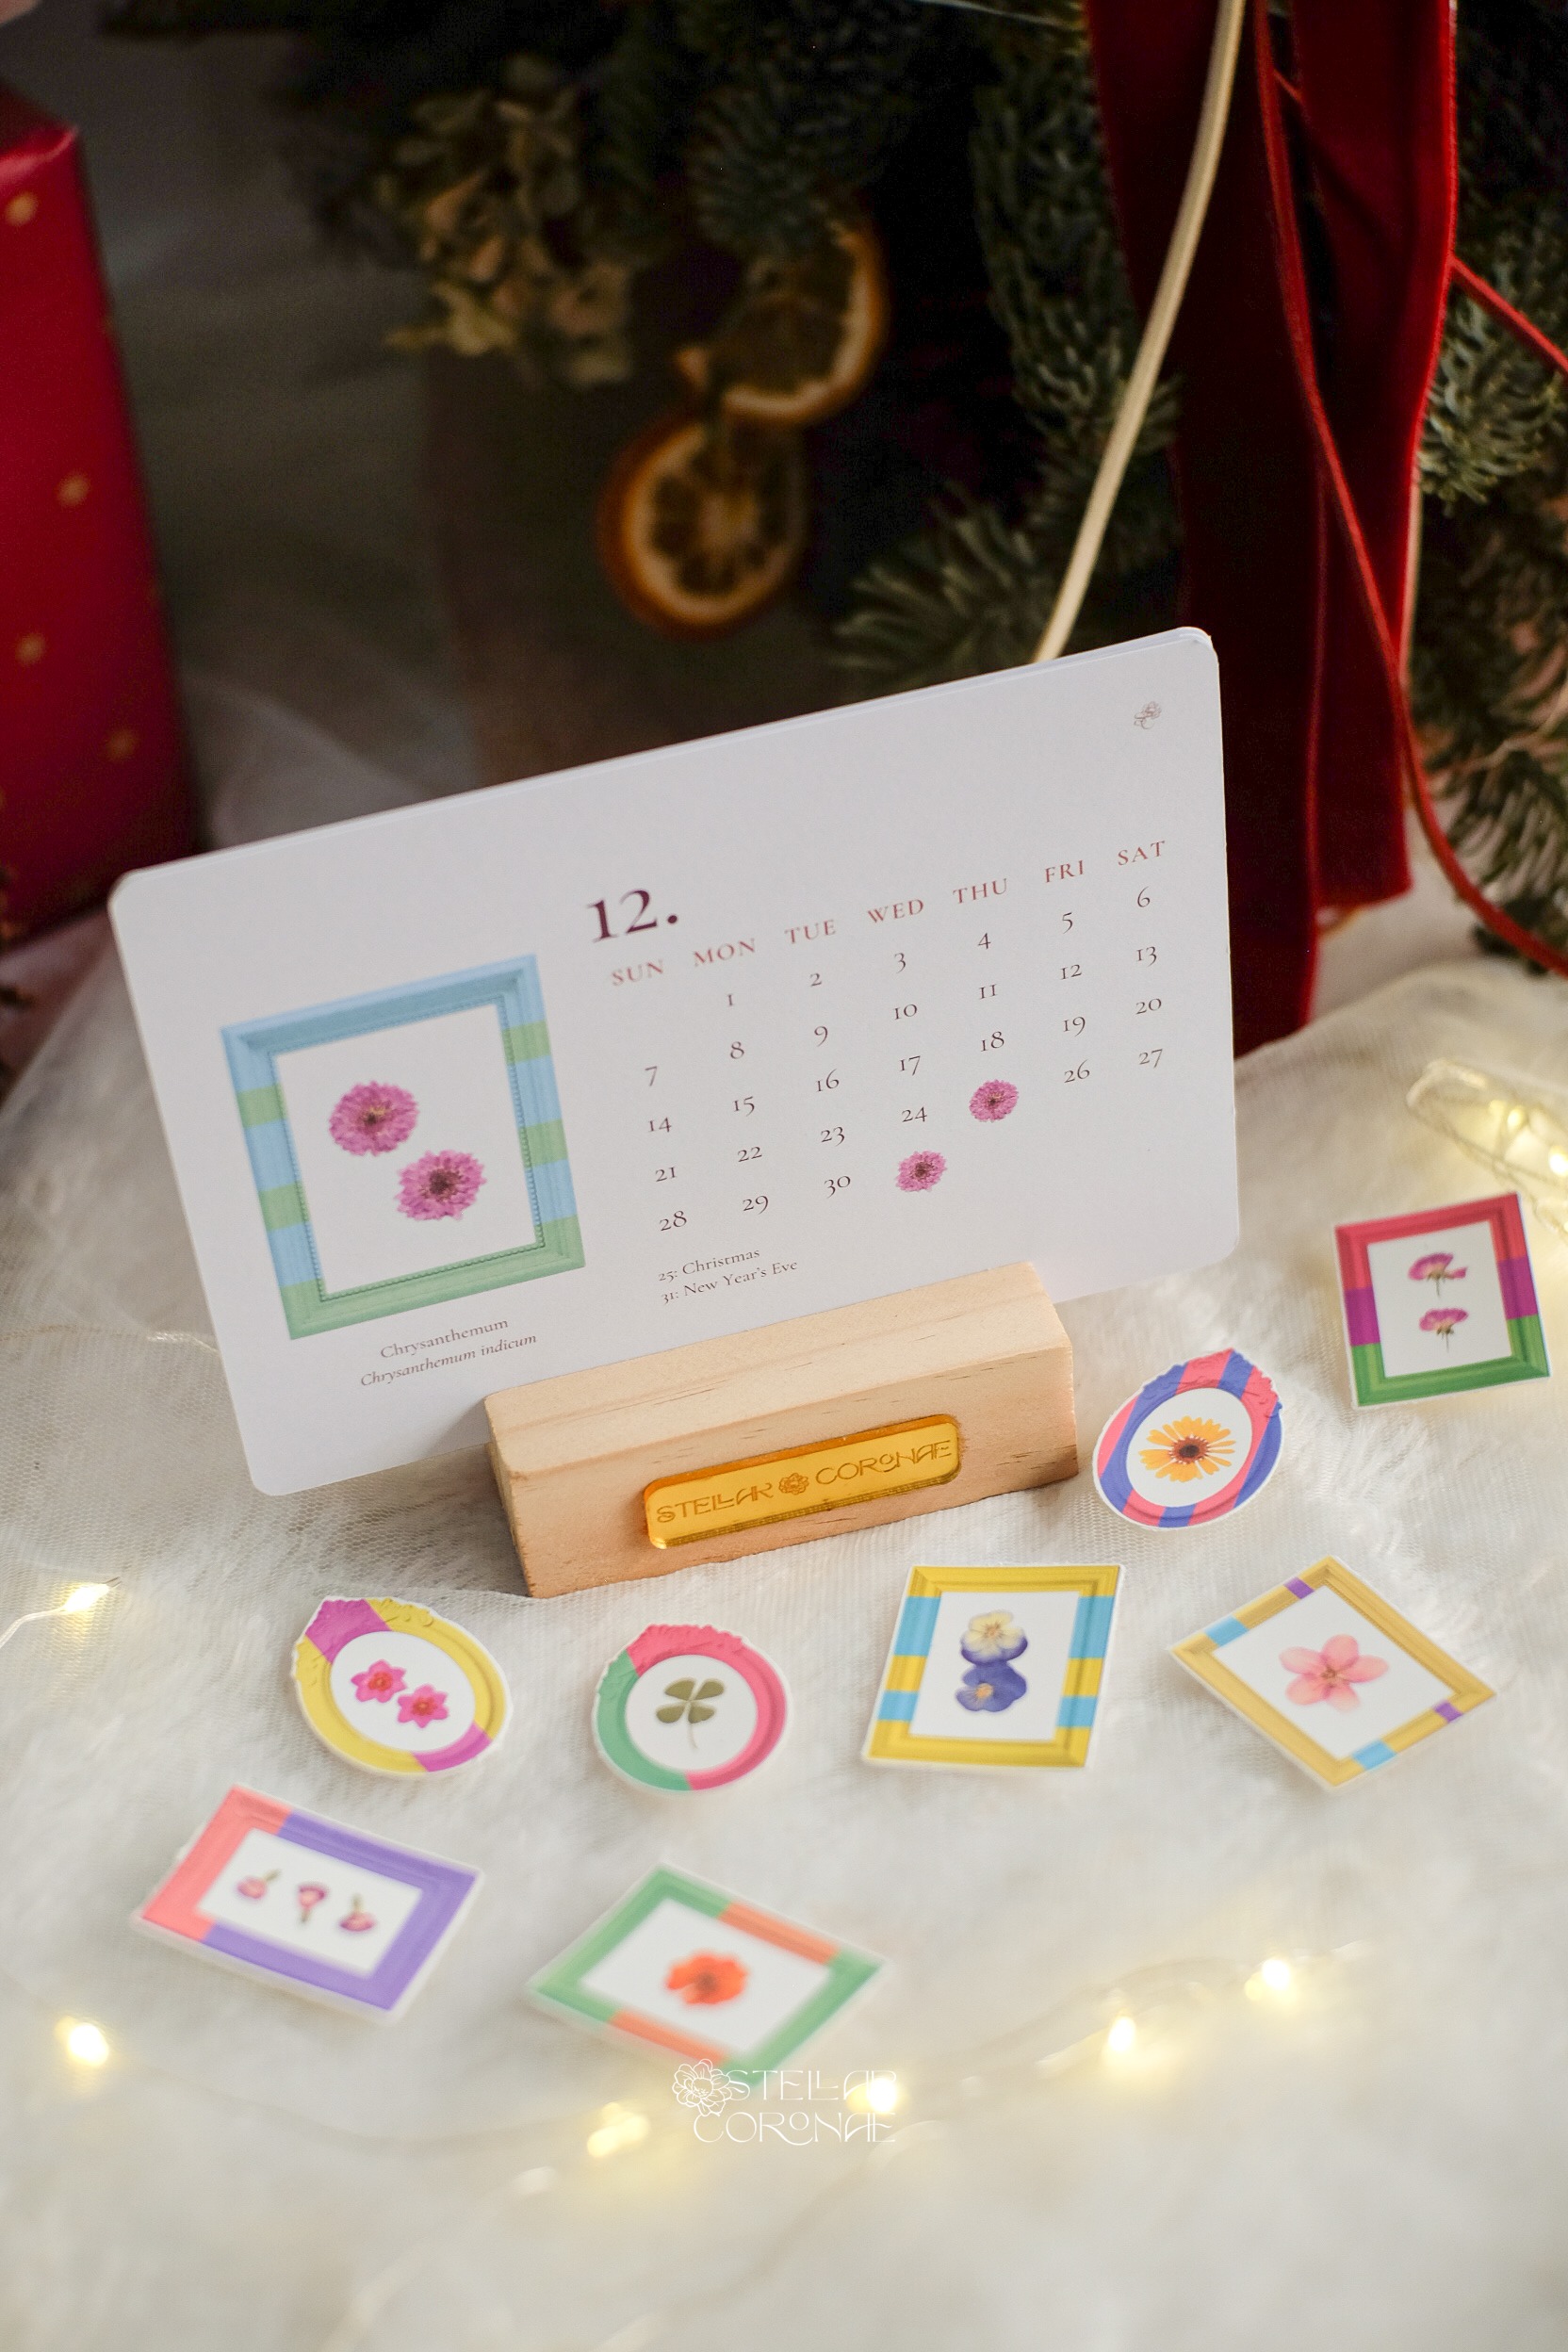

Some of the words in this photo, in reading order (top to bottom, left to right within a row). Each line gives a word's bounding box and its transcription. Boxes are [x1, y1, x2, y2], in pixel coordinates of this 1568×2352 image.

[586, 888, 679, 943] 12.
[611, 959, 664, 987] SUN
[693, 938, 756, 967] MON
[784, 919, 837, 944] TUE
[867, 898, 924, 924] WED
[952, 877, 1008, 905] THU
[1044, 859, 1085, 883] FRI
[1117, 840, 1166, 866] SAT
[727, 992, 734, 1007] 1
[809, 972, 823, 988] 2
[893, 952, 906, 974] 3
[976, 932, 992, 951] 4
[1061, 911, 1074, 935] 5
[1135, 886, 1152, 908] 6
[644, 1065, 659, 1087] 7
[728, 1040, 745, 1060] 8
[813, 1025, 829, 1048] 9
[893, 1004, 919, 1021] 10
[978, 983, 999, 1001] 11
[1059, 963, 1083, 981] 12
[1135, 945, 1158, 968] 13
[647, 1116, 673, 1134] 14
[732, 1095, 756, 1118] 15
[815, 1068, 841, 1093] 16
[899, 1054, 922, 1077] 17
[980, 1030, 1005, 1053] 18
[1062, 1016, 1086, 1037] 19
[1135, 997, 1163, 1016] 20
[654, 1166, 678, 1183] 21
[737, 1146, 763, 1163] 22
[820, 1126, 845, 1148] 23
[901, 1105, 928, 1123] 24
[1063, 1058, 1091, 1084] 26
[1138, 1048, 1164, 1070] 27
[659, 1211, 688, 1232] 28
[742, 1195, 770, 1216] 29
[824, 1175, 852, 1200] 30
[658, 1269, 678, 1283] 25:
[682, 1250, 761, 1275] Christmas
[662, 1291, 678, 1305] 31:
[684, 1274, 718, 1297] New
[772, 1261, 798, 1275] Eve
[360, 1350, 477, 1387] Chrysanthemum
[481, 1334, 537, 1356] indicum
[380, 1319, 509, 1359] Chrysanthemum
[656, 1482, 774, 1524] STELLAR
